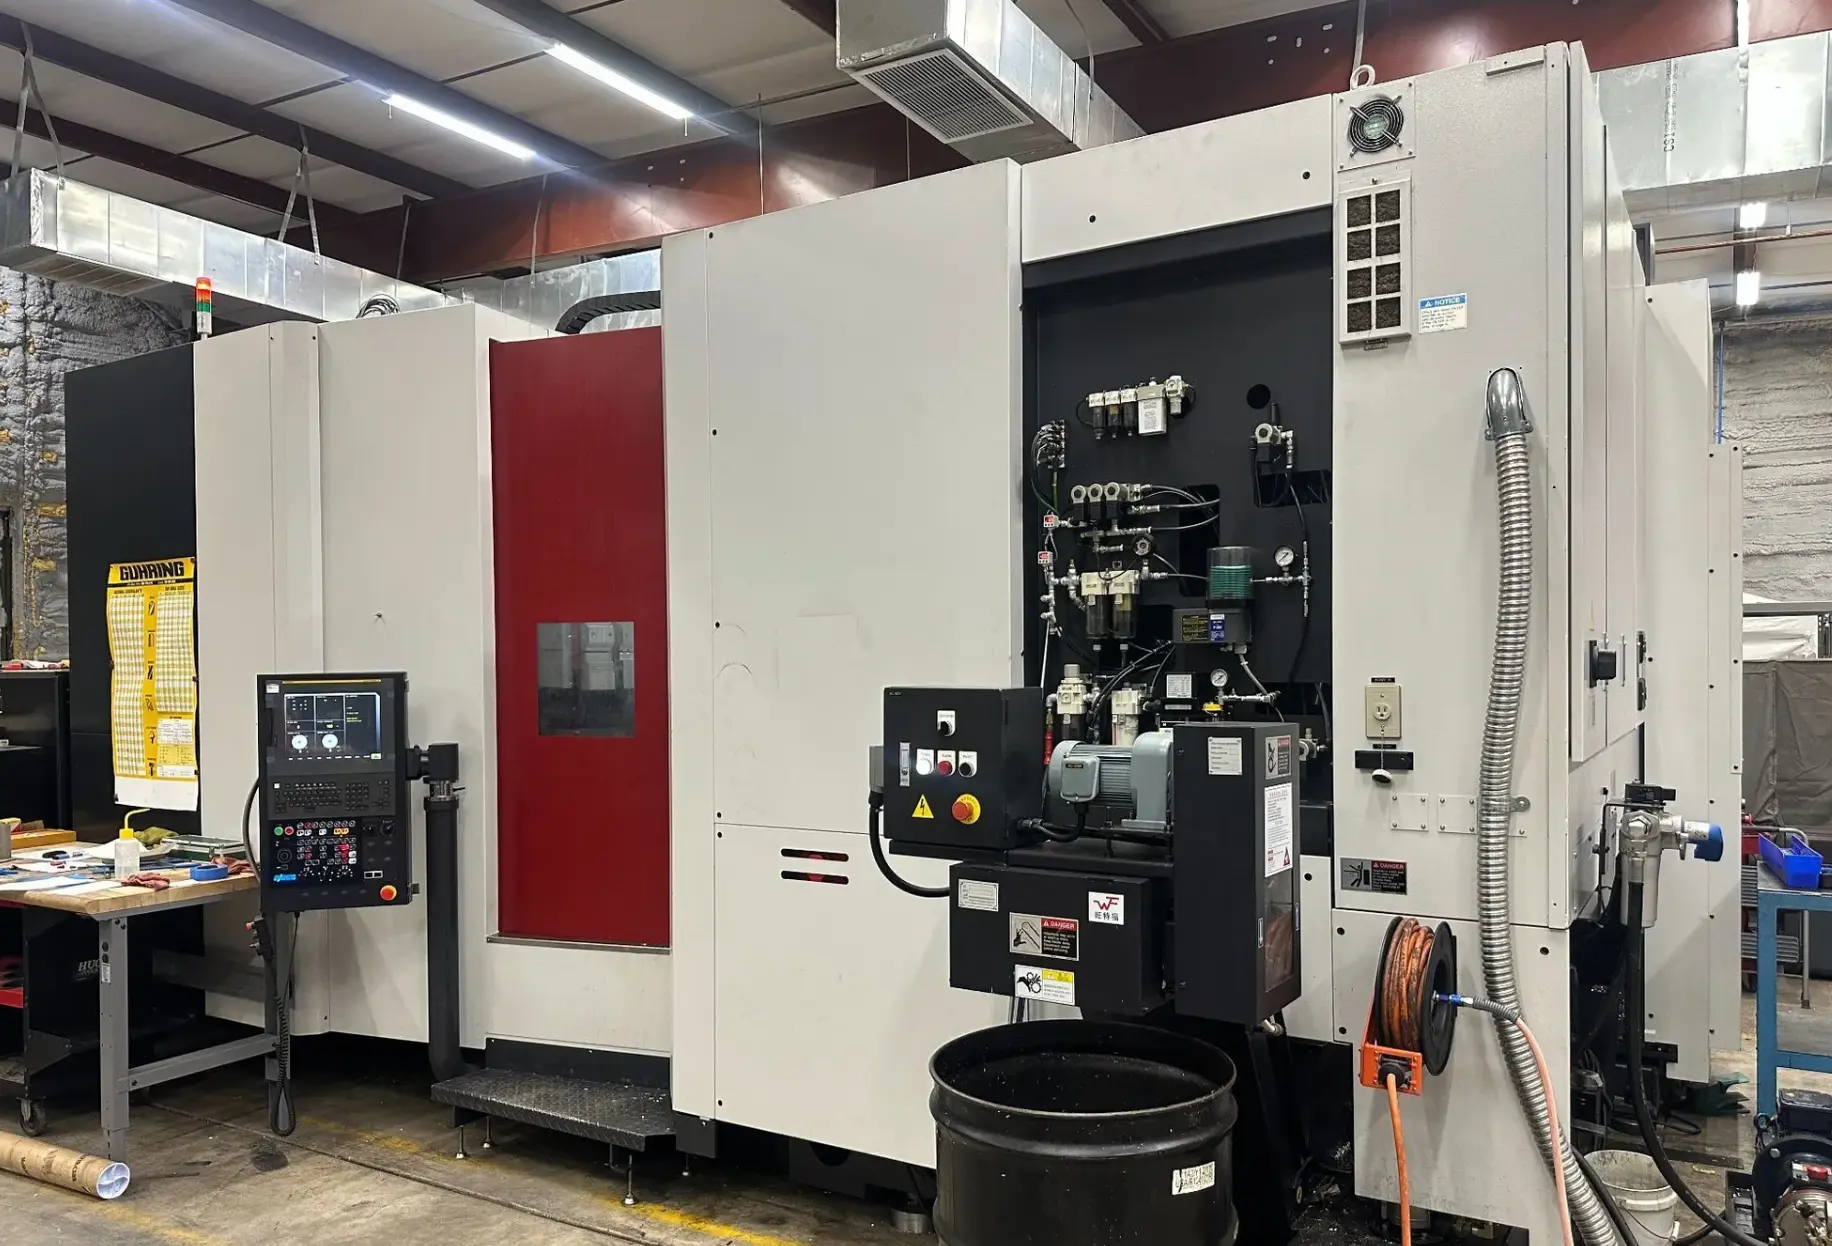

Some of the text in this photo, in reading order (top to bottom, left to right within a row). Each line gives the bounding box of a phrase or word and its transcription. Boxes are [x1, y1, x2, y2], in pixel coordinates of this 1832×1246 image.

[1434, 296, 1461, 307] NOTICE
[119, 561, 185, 581] GUHRING
[1379, 862, 1404, 871] DANGER
[1050, 920, 1075, 930] DANGER
